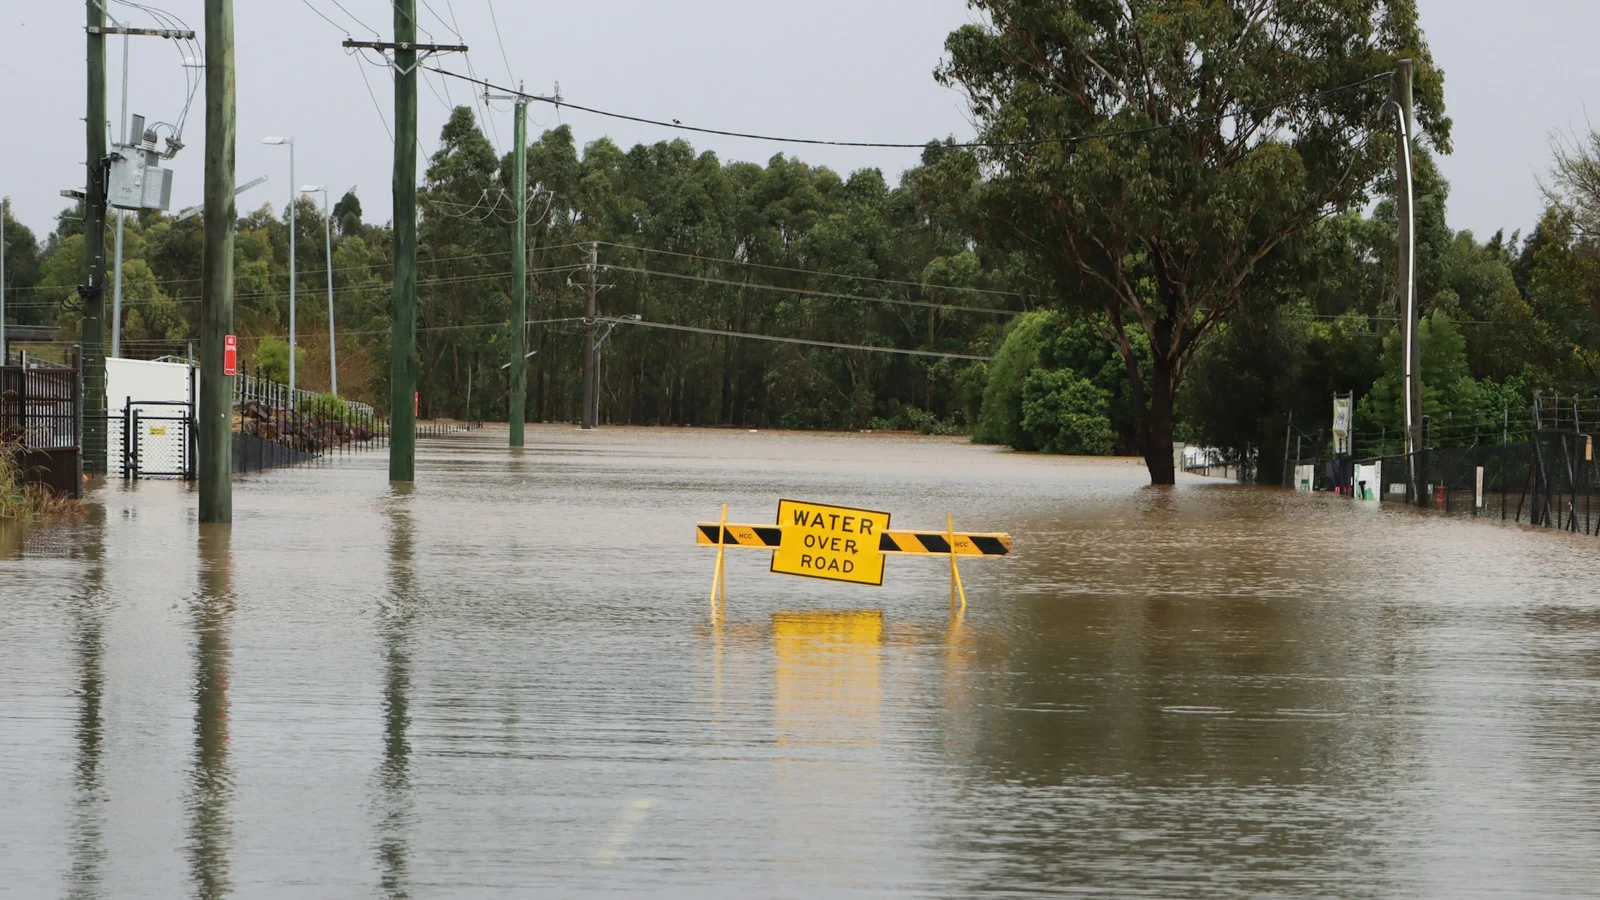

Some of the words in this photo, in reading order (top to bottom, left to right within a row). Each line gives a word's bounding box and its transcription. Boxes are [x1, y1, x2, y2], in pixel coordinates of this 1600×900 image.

[794, 509, 873, 535] WATER
[804, 534, 858, 555] OVER
[801, 554, 854, 573] ROAD
